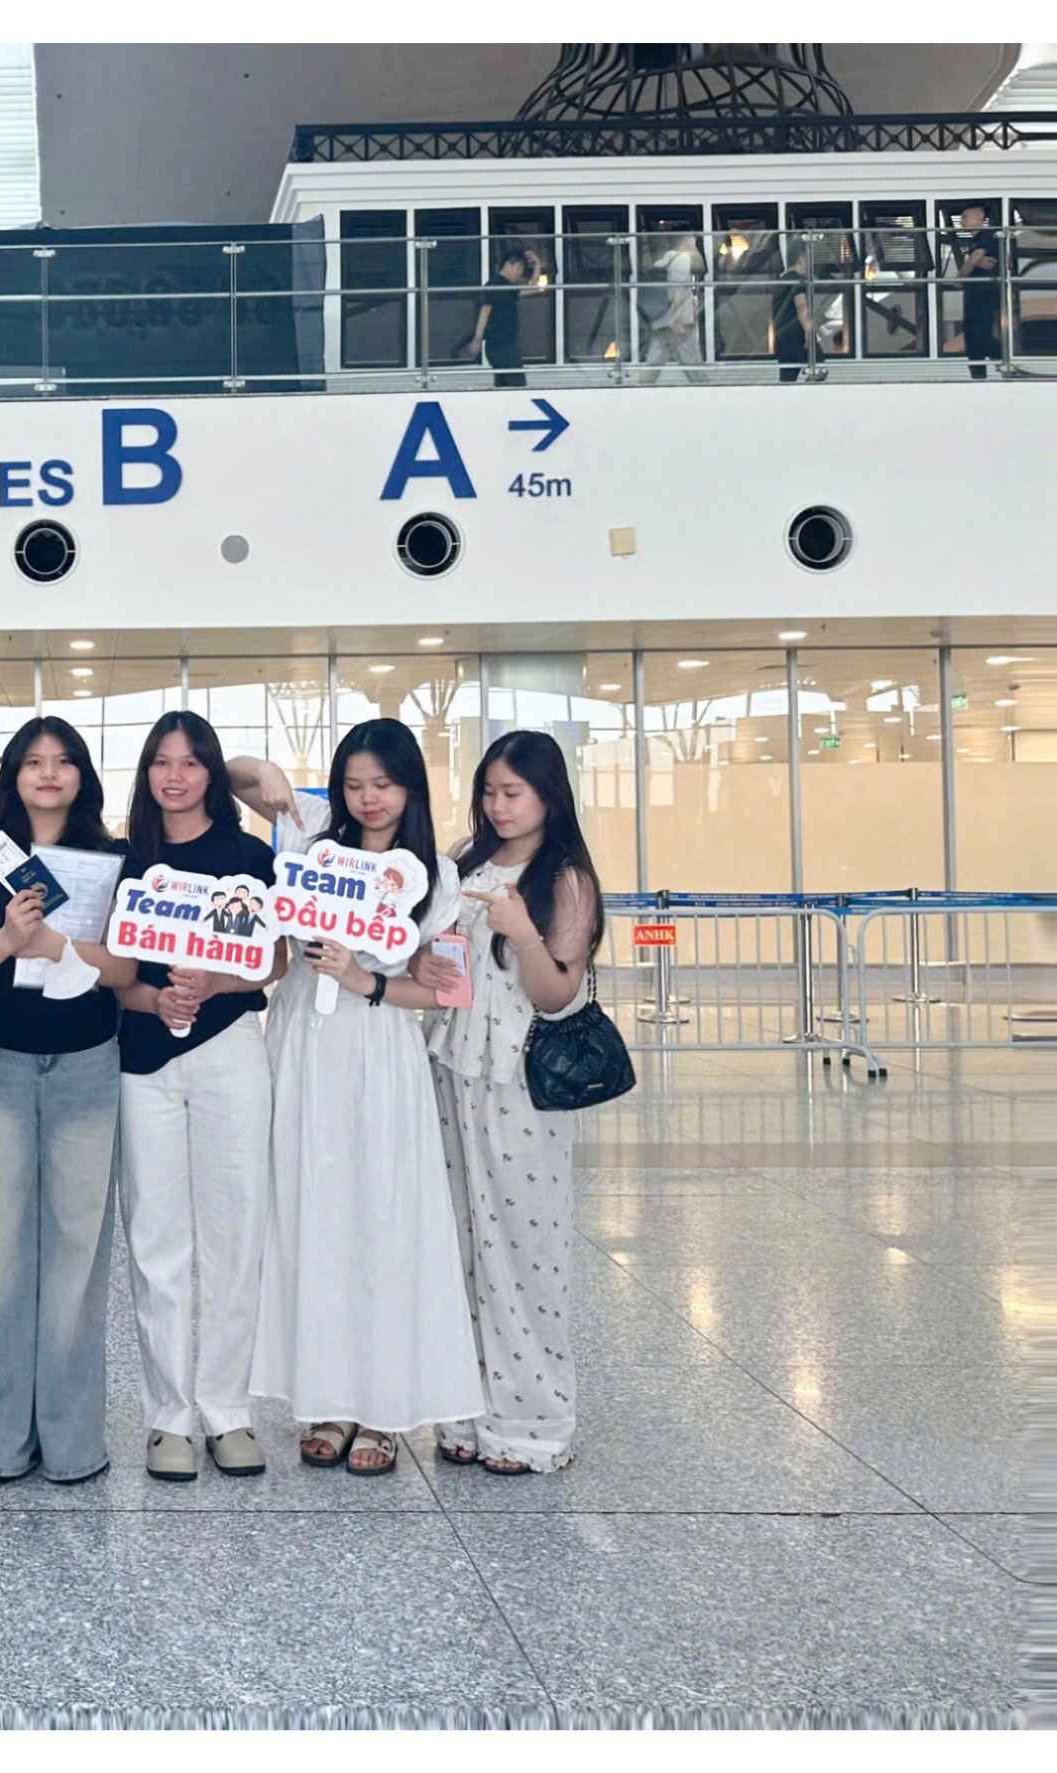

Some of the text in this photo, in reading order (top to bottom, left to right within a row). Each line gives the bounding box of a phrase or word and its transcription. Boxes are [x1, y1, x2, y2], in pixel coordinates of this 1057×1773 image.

[102, 408, 183, 505] B
[380, 401, 477, 501] A
[508, 473, 572, 498] 45m
[284, 861, 366, 901] Team
[338, 855, 378, 873] WIRLINK
[126, 888, 202, 922] Team
[170, 880, 210, 896] WIRLINK
[274, 895, 337, 932] Đầu
[117, 920, 264, 970] Bán hàng
[636, 928, 675, 942] ANHK
